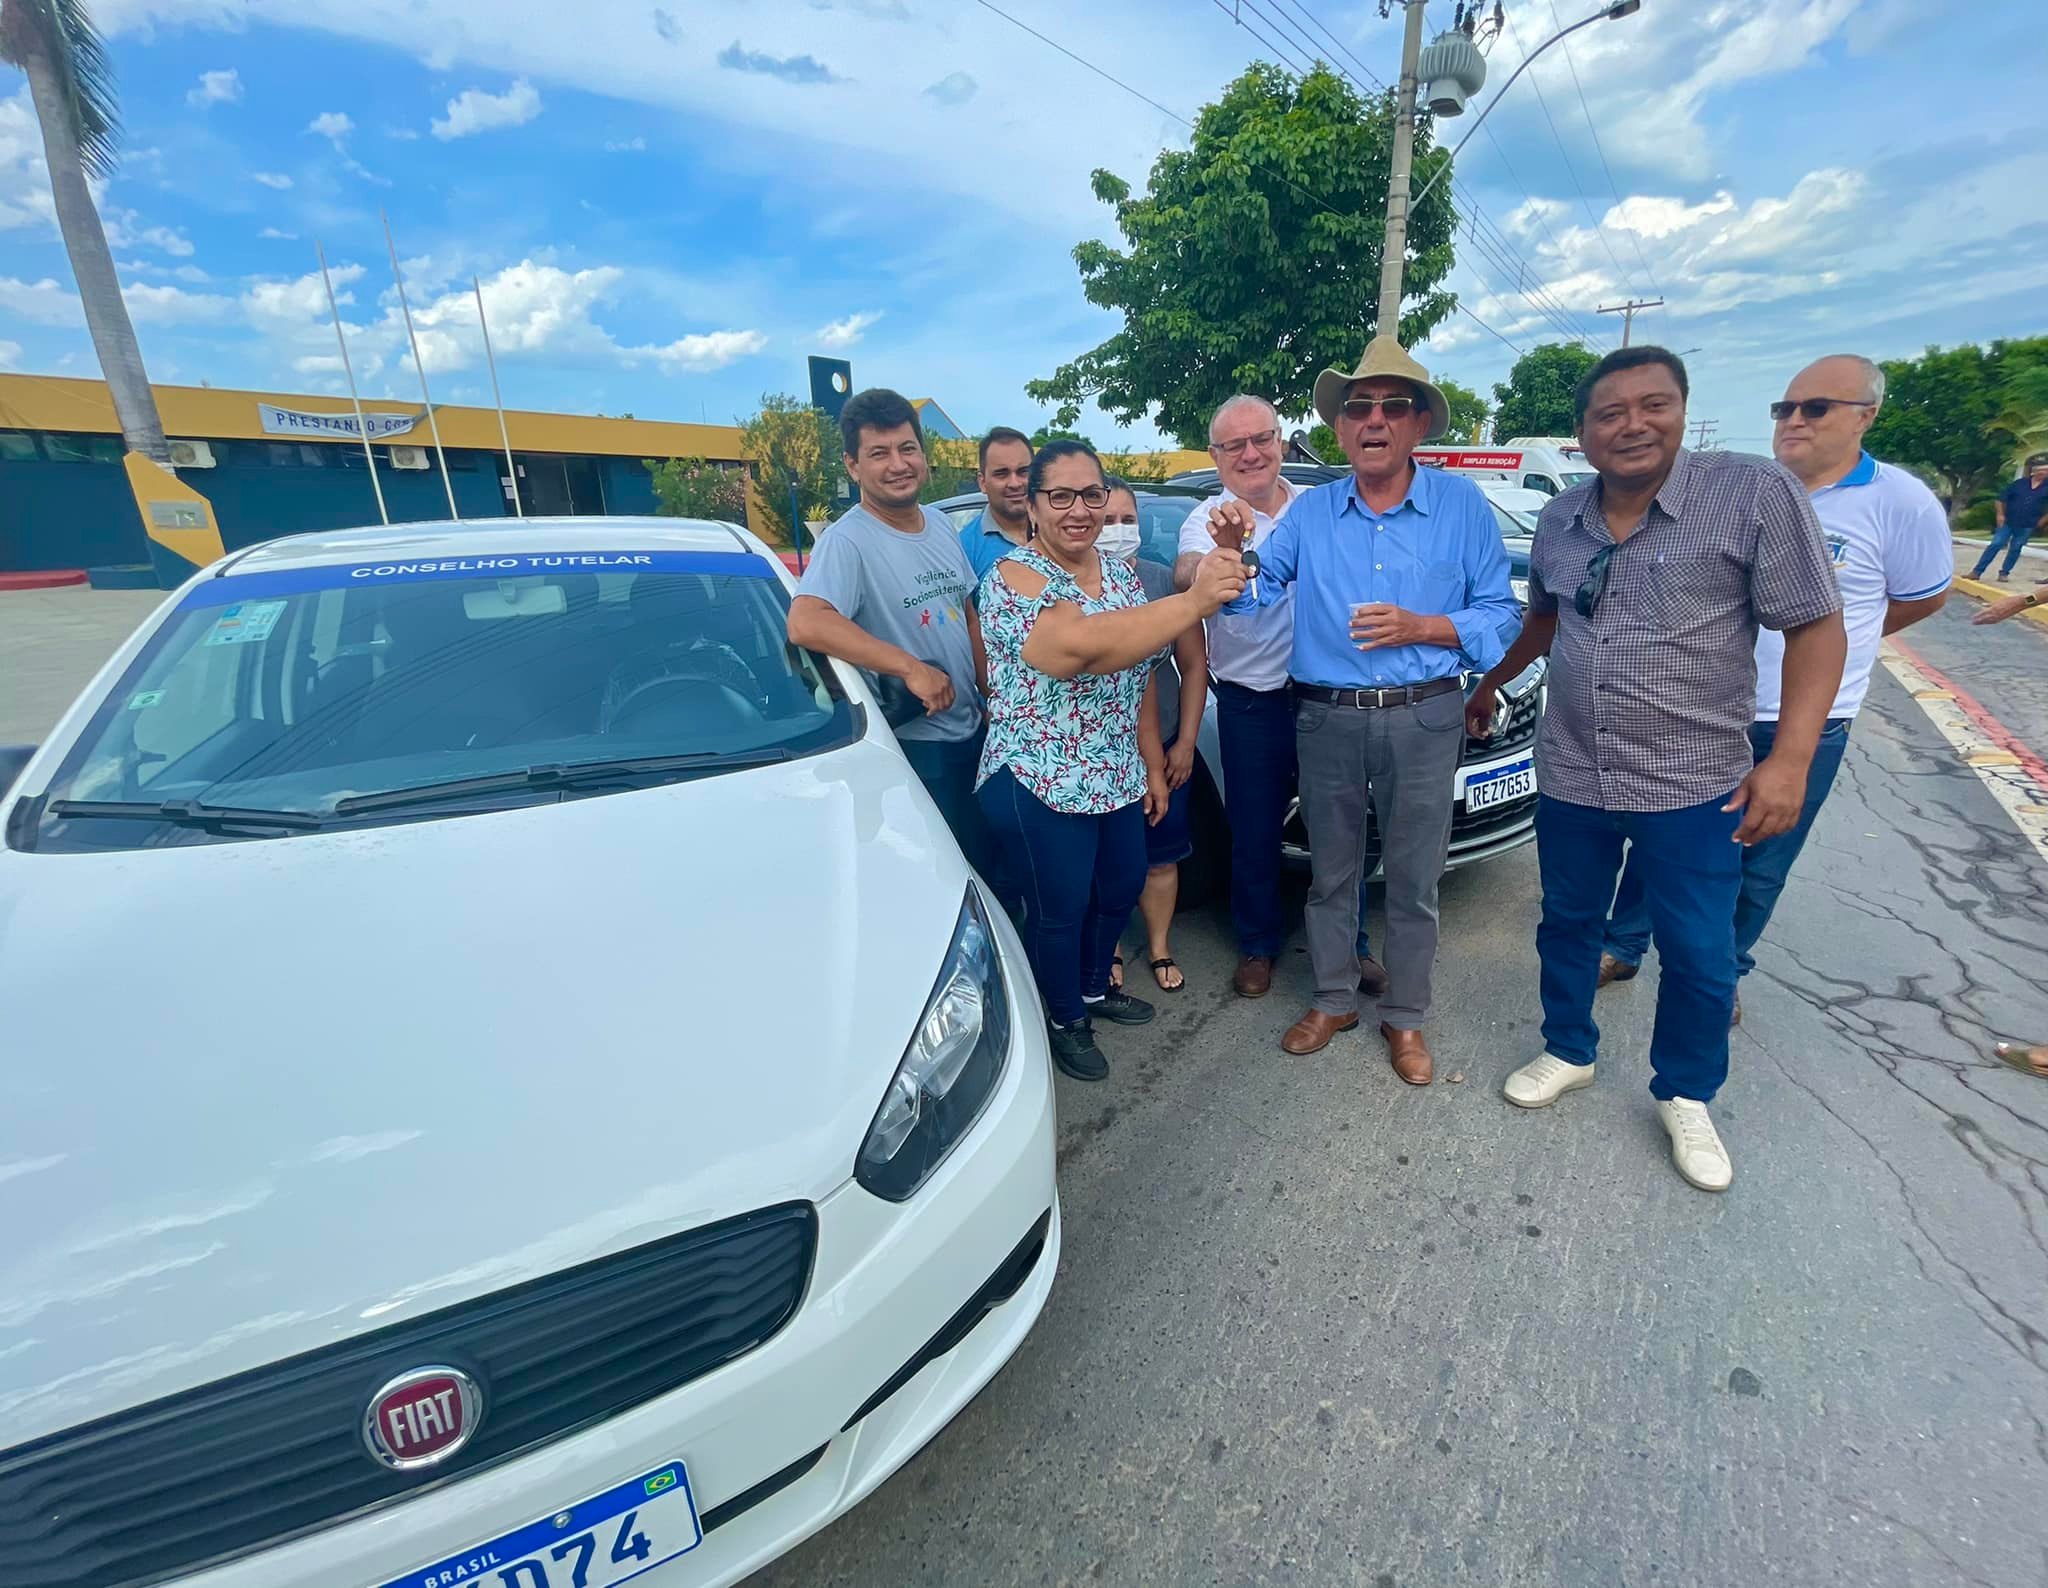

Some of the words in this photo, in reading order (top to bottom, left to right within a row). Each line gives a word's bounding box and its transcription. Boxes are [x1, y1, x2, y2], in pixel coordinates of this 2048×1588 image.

[1462, 457, 1487, 465] SIMPLES
[1487, 456, 1517, 466] REMOÇÃO
[351, 558, 519, 578] CONSELHO
[527, 555, 652, 567] TUTELAR
[1473, 772, 1530, 808] REZ7G53
[388, 1388, 454, 1449] FIAT
[466, 1511, 652, 1588] D74
[424, 1551, 501, 1588] BRASIL
